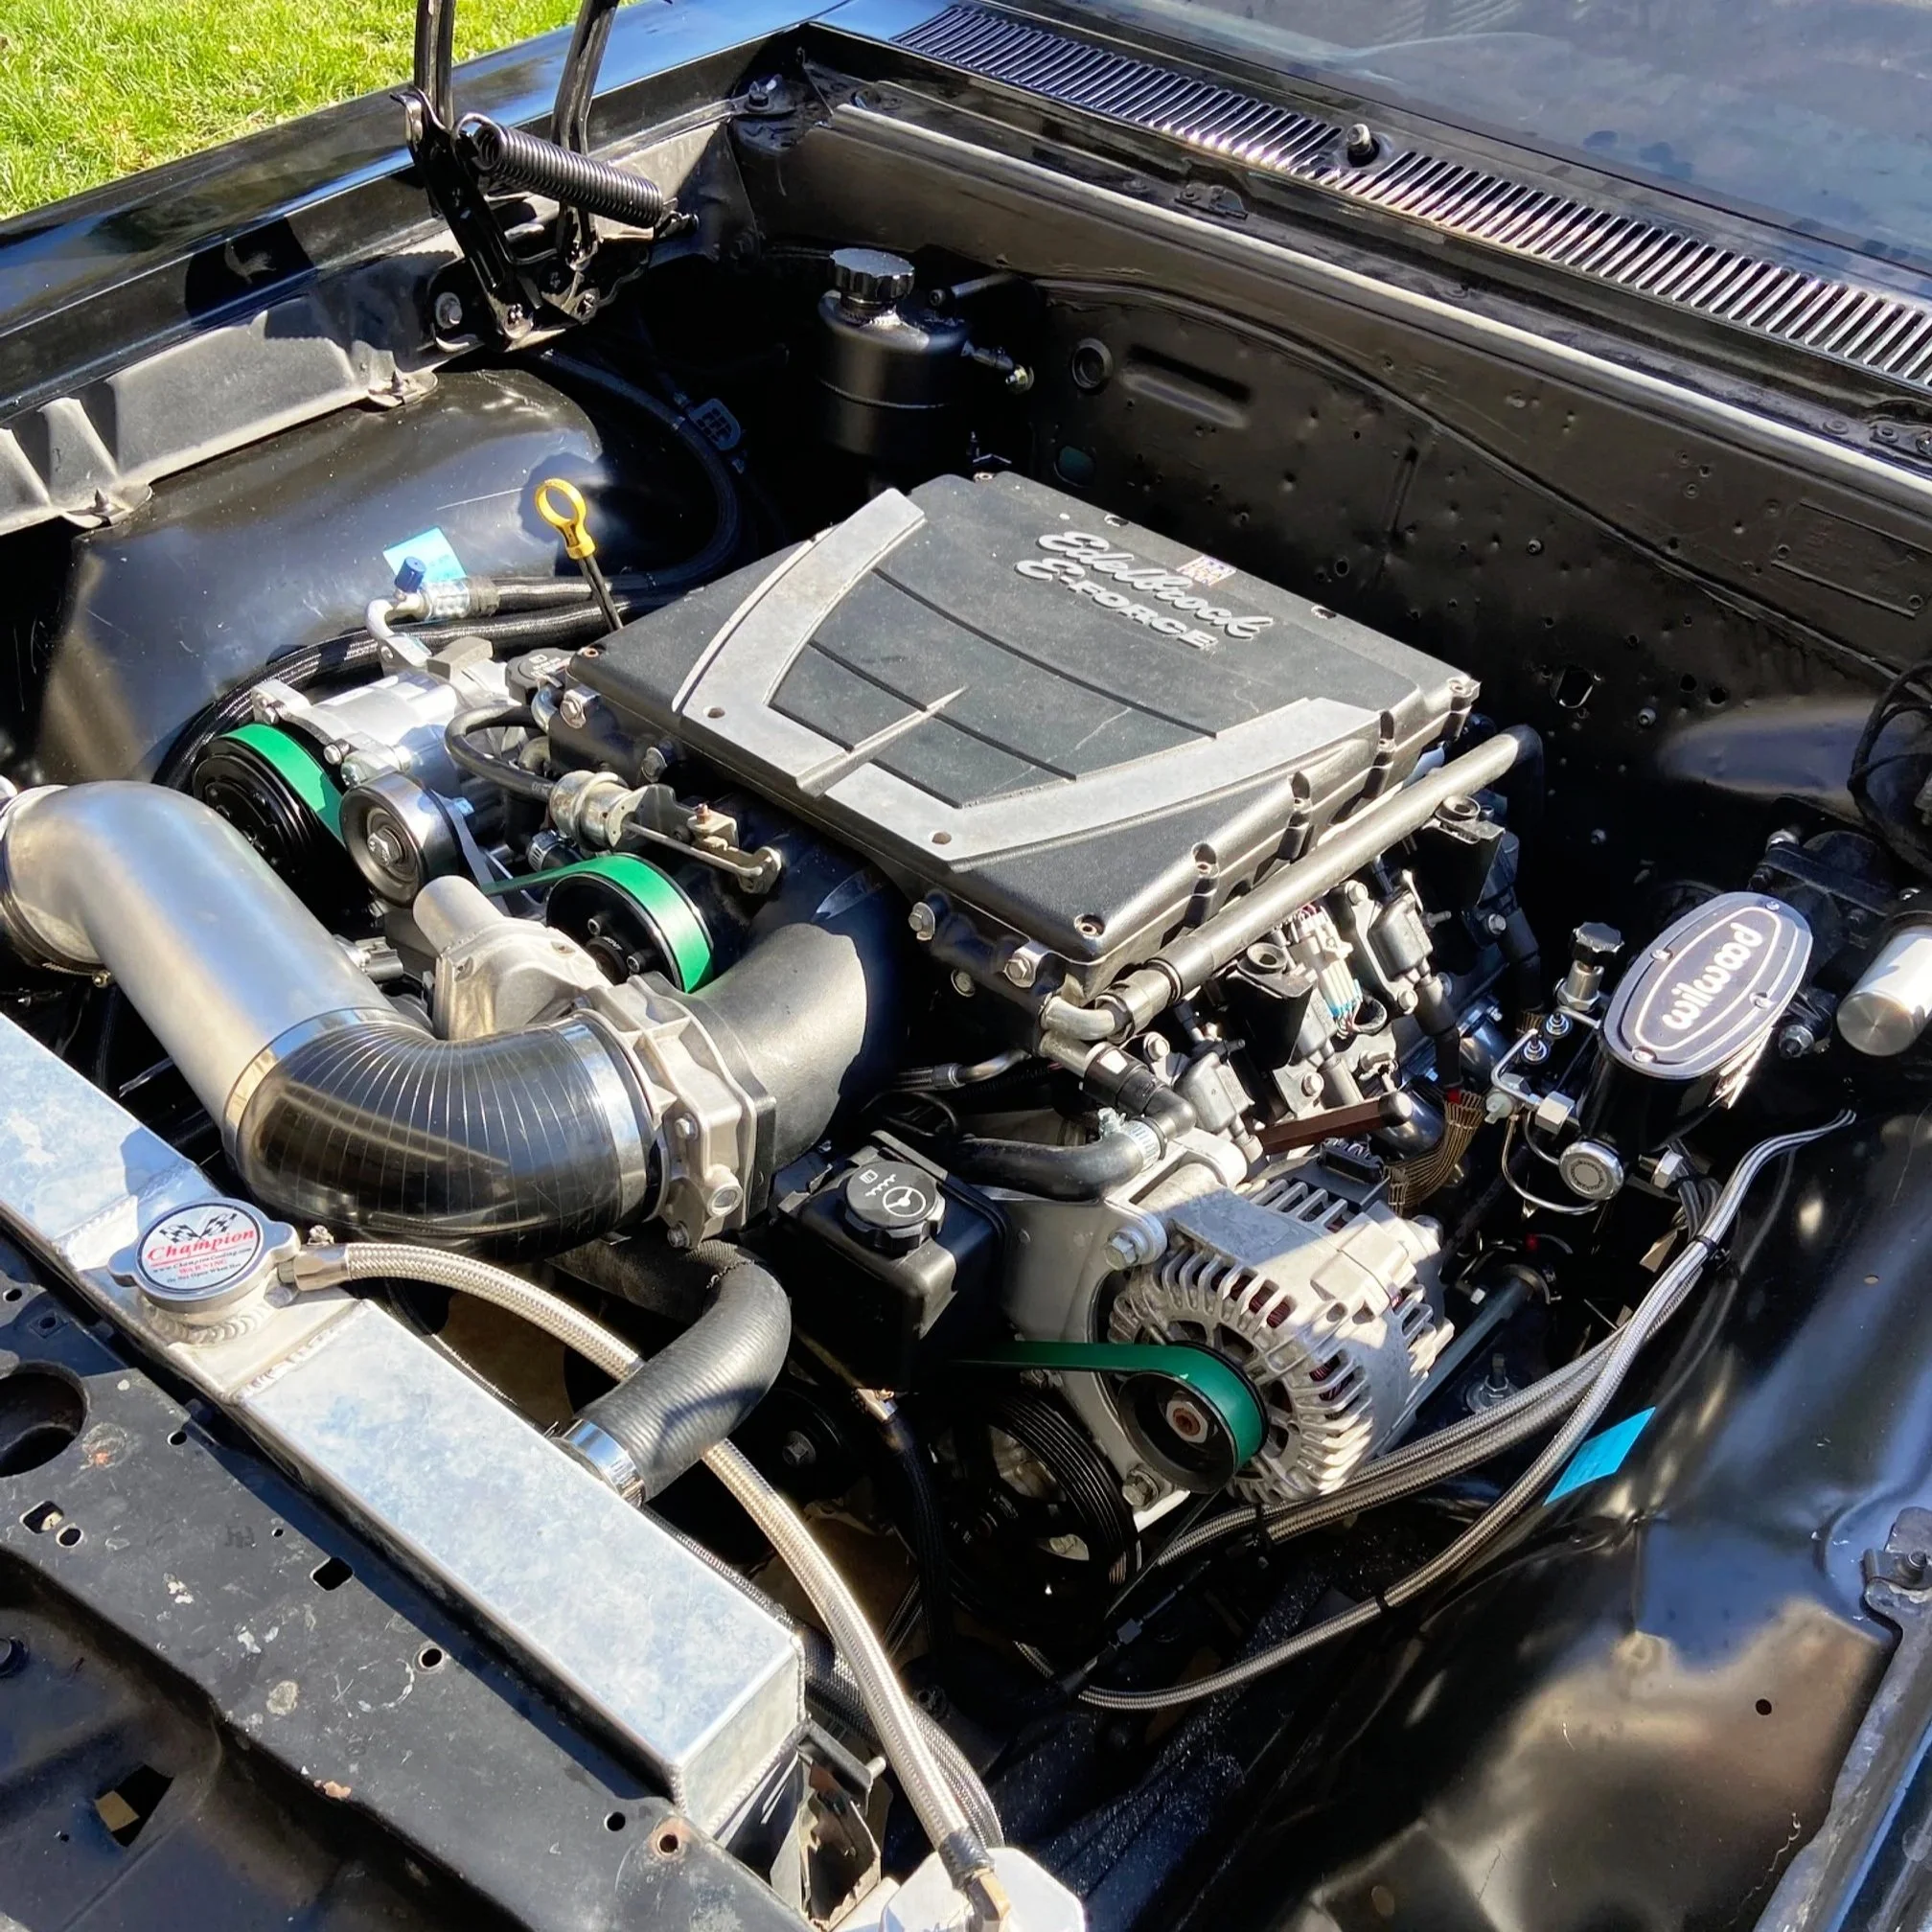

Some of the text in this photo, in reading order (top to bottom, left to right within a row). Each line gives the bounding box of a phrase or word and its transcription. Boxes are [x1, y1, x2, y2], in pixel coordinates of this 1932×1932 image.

[1015, 558, 1218, 648] E-FORCE
[1037, 531, 1274, 639] Edelbrock
[1662, 922, 1763, 1029] wilwood
[147, 1230, 254, 1261] Champion
[178, 1259, 226, 1274] WARNING
